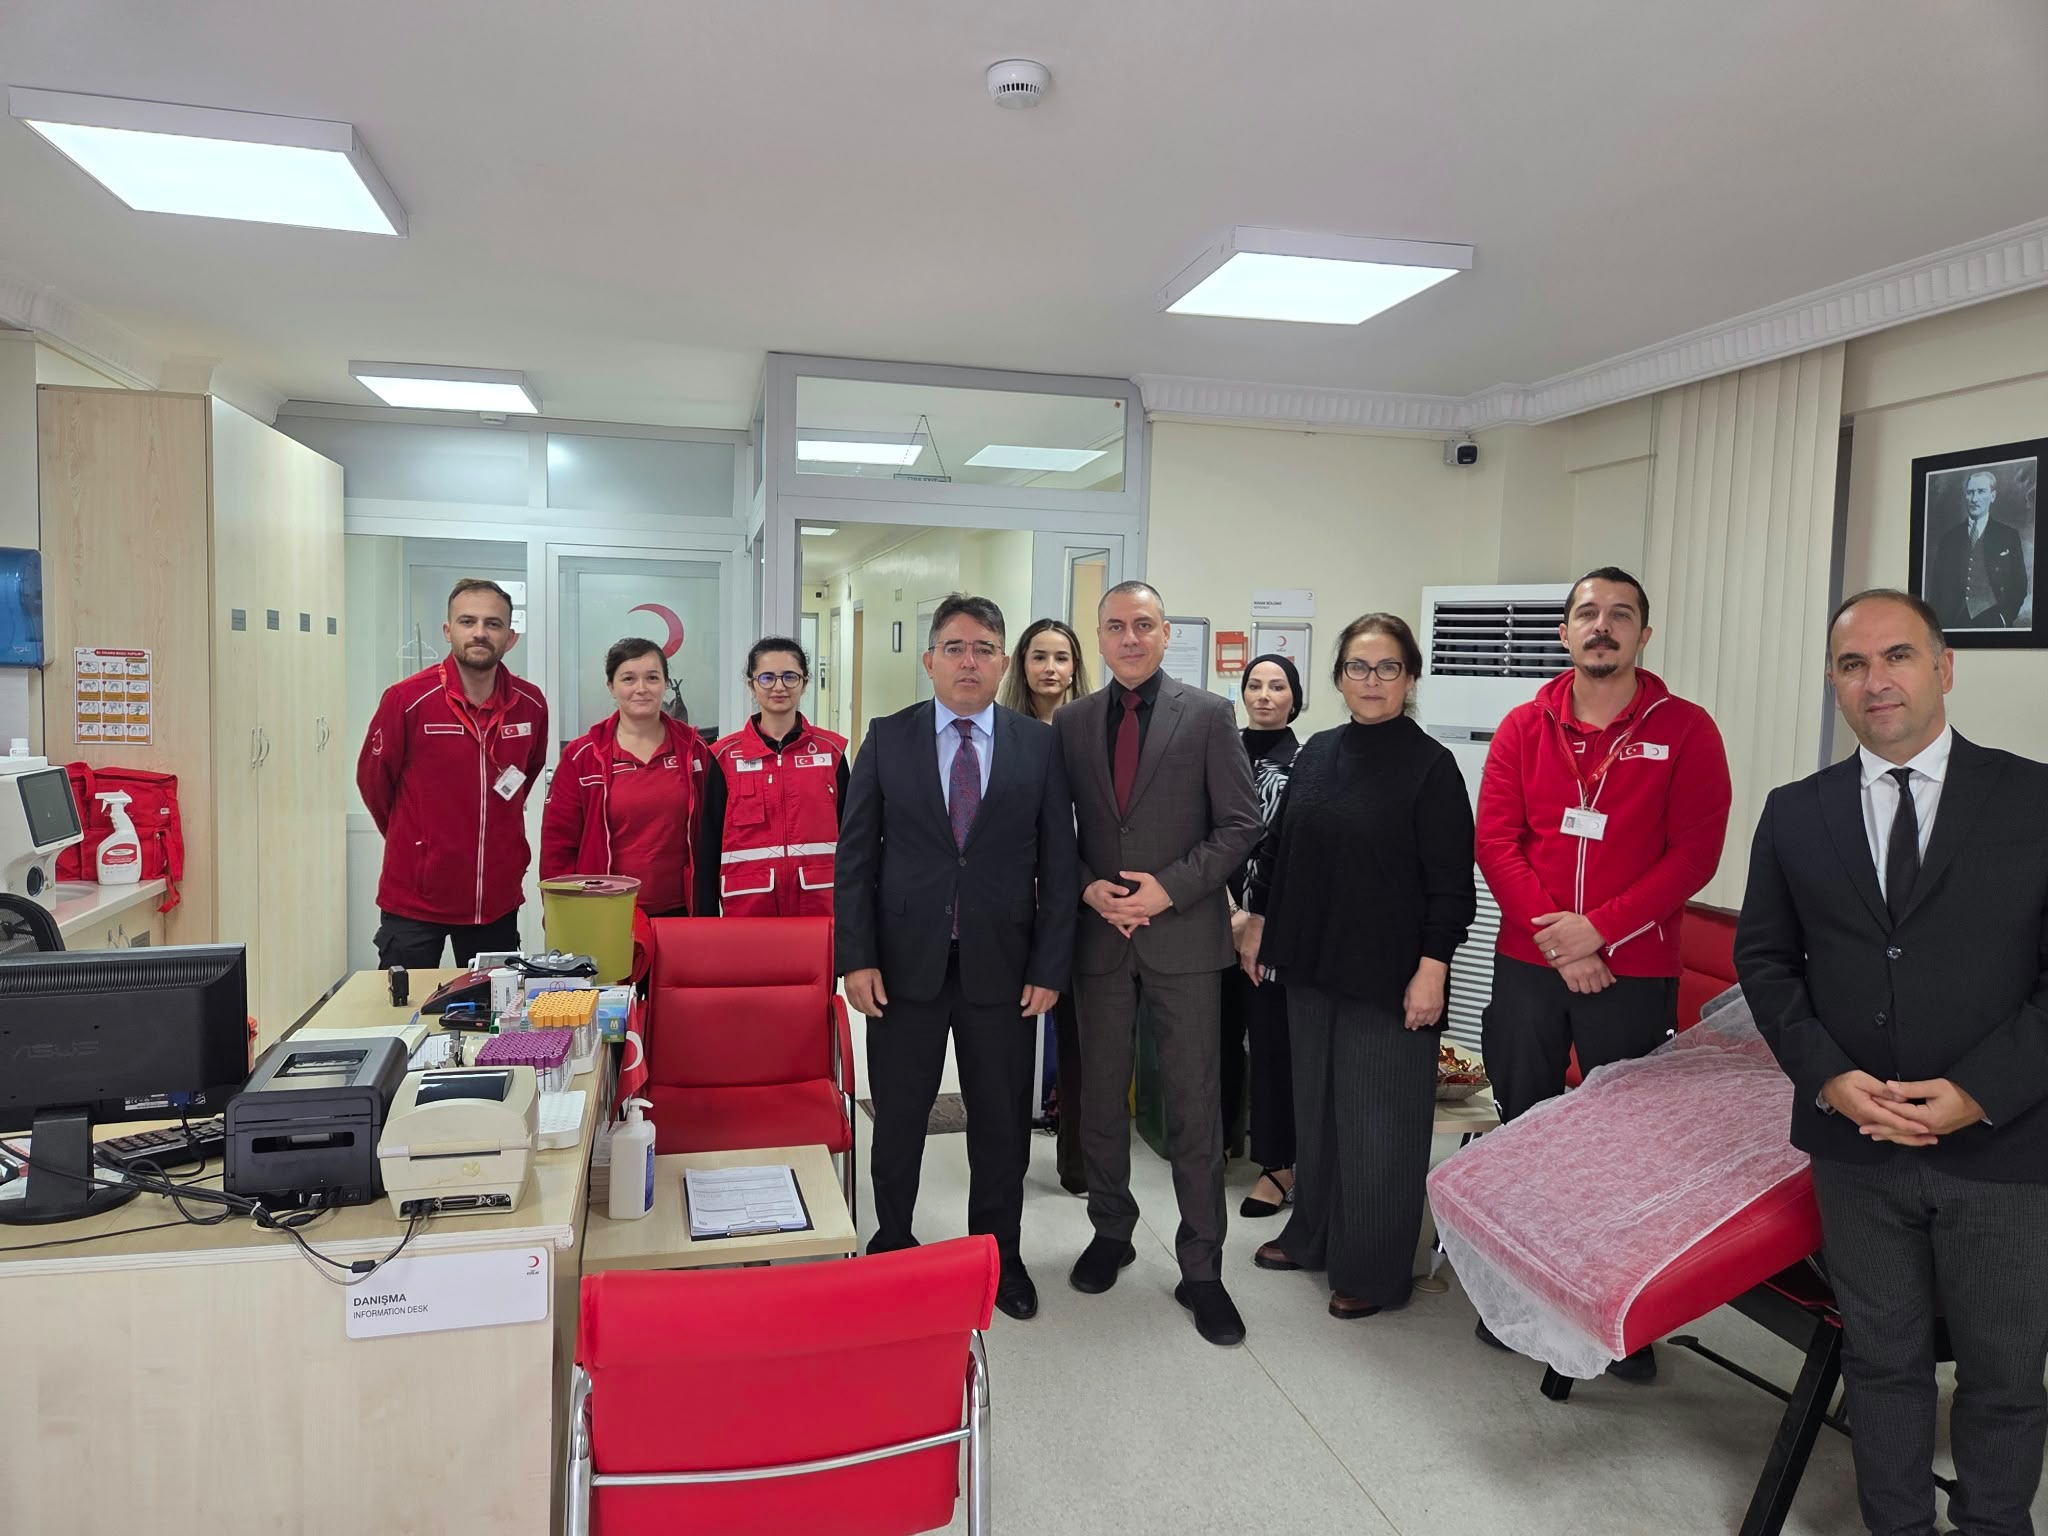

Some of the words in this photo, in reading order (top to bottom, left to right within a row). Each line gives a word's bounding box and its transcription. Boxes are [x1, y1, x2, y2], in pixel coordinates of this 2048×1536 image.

[13, 1040, 100, 1060] ASUS
[353, 1293, 407, 1307] DANIŞMA
[353, 1306, 406, 1319] INFORMATION
[407, 1304, 429, 1314] DESK
